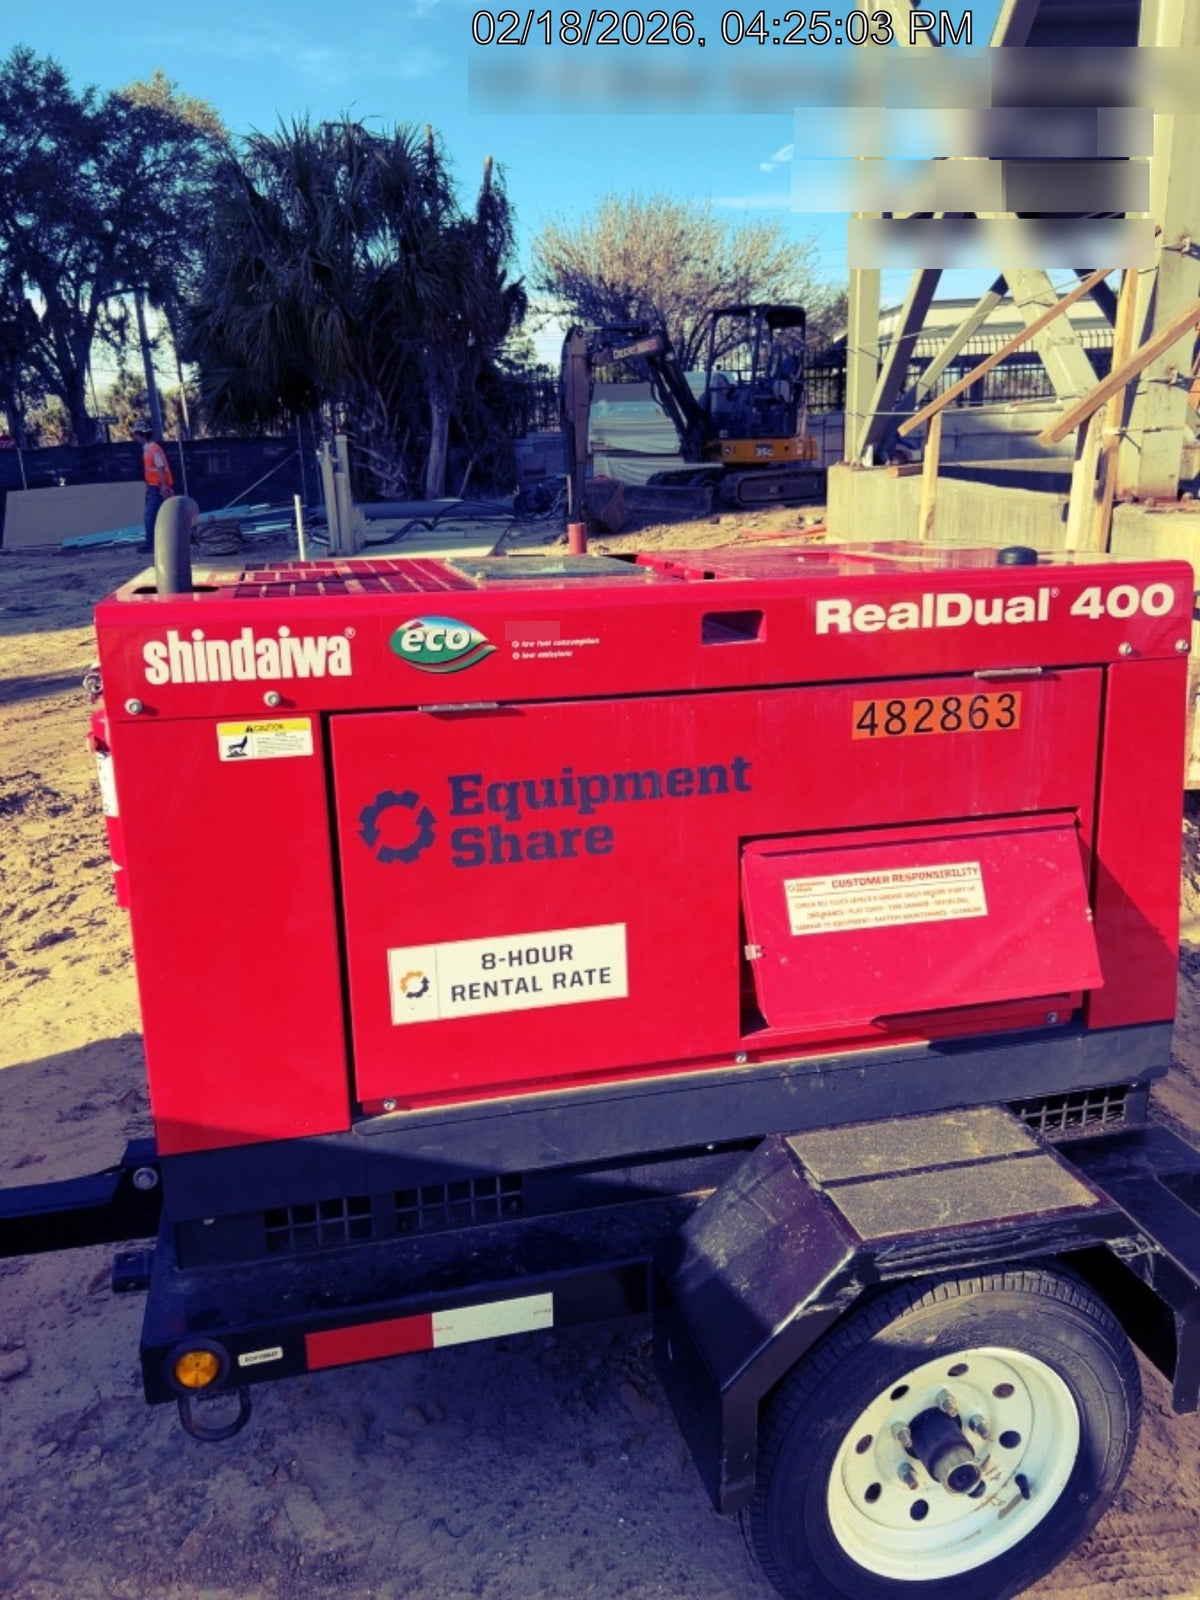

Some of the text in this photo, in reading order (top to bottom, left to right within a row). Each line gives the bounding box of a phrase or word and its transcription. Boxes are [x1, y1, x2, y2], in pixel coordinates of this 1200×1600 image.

[1070, 583, 1175, 620] 400
[856, 693, 1016, 736] 482863
[448, 756, 752, 822] Equipment
[450, 825, 615, 868] Share
[832, 875, 889, 888] CUSTOMER
[892, 867, 978, 882] RESPONSIBILITY
[481, 944, 573, 970] 8-HOUR
[451, 967, 611, 1002] RENTAL RATE
